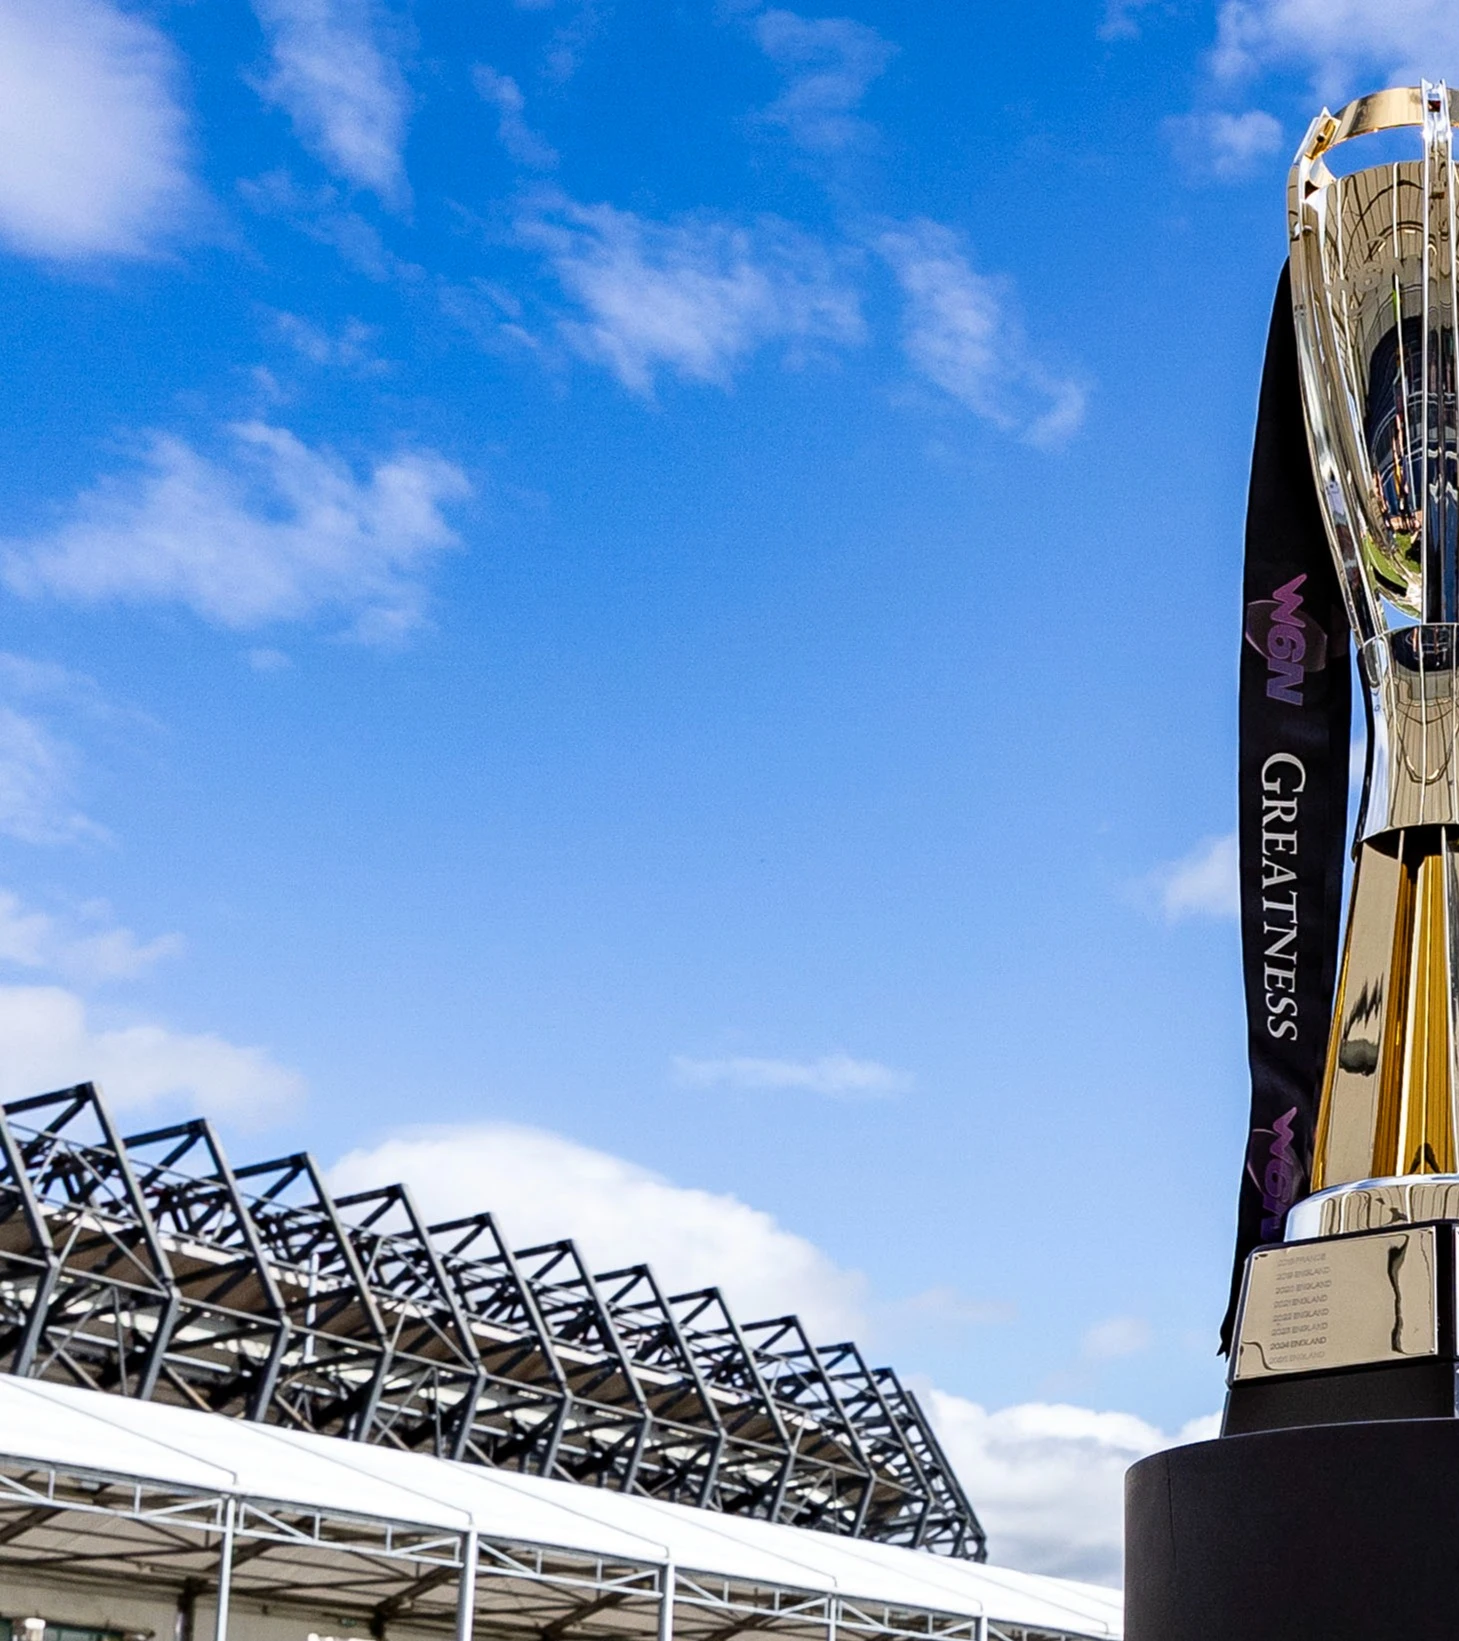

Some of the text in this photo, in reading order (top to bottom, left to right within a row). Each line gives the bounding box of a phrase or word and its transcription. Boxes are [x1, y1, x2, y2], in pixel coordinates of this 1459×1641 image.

[1266, 573, 1308, 707] W6N
[1261, 752, 1306, 1041] GREATNESS
[1295, 1252, 1326, 1265] FRANCE
[1294, 1266, 1331, 1278] ENGLAND
[1296, 1280, 1332, 1292] ENGLAND
[1292, 1294, 1328, 1306] ENGLAND
[1293, 1308, 1329, 1320] ENGLAND
[1292, 1322, 1328, 1334] ENGLAND
[1269, 1336, 1327, 1350] 2024 ENGLAND
[1289, 1350, 1325, 1362] ENGLAND
